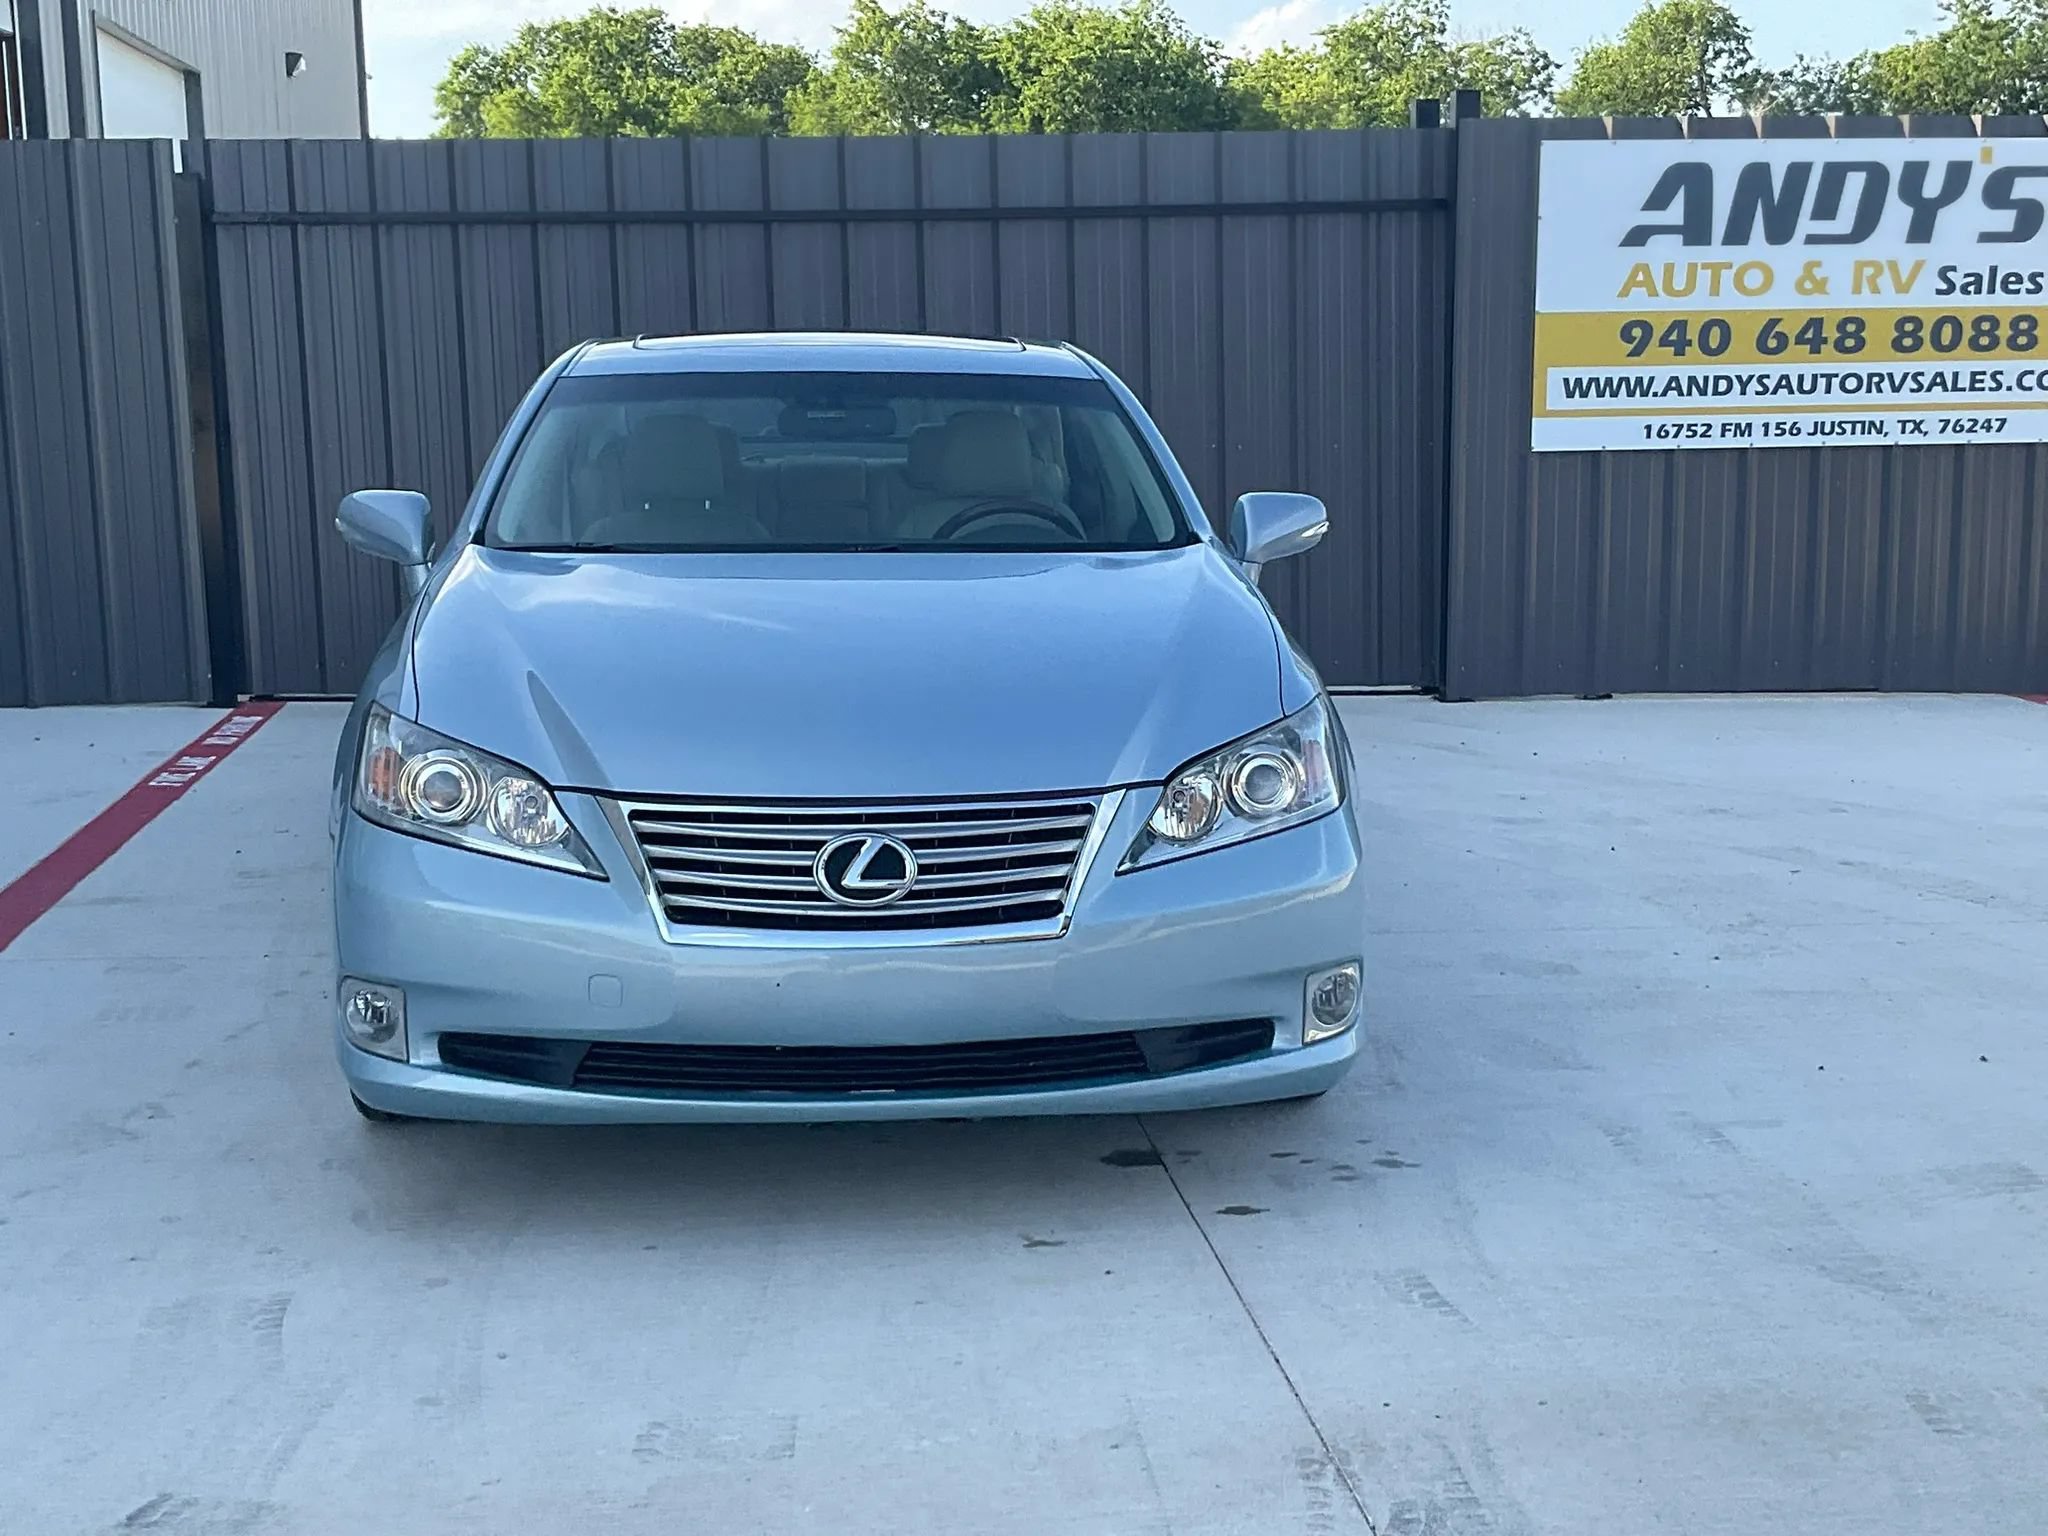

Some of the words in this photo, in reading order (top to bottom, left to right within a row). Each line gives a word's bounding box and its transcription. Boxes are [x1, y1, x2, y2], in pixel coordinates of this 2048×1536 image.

[1618, 147, 2048, 247] ANDY'S
[1617, 261, 1774, 297] AUTO
[1795, 261, 1829, 295] &
[1852, 259, 1926, 295] RV
[1935, 265, 2044, 295] Sales
[1620, 318, 1732, 357] 940
[1756, 316, 1866, 355] 648
[1891, 314, 2038, 353] 8088
[1643, 423, 1713, 440] 16752
[1720, 422, 1753, 438] FM
[1762, 421, 1801, 437] 156
[1807, 420, 1889, 437] JUSTIN,
[1897, 419, 1929, 437] TX,
[1938, 417, 2007, 434] 76247
